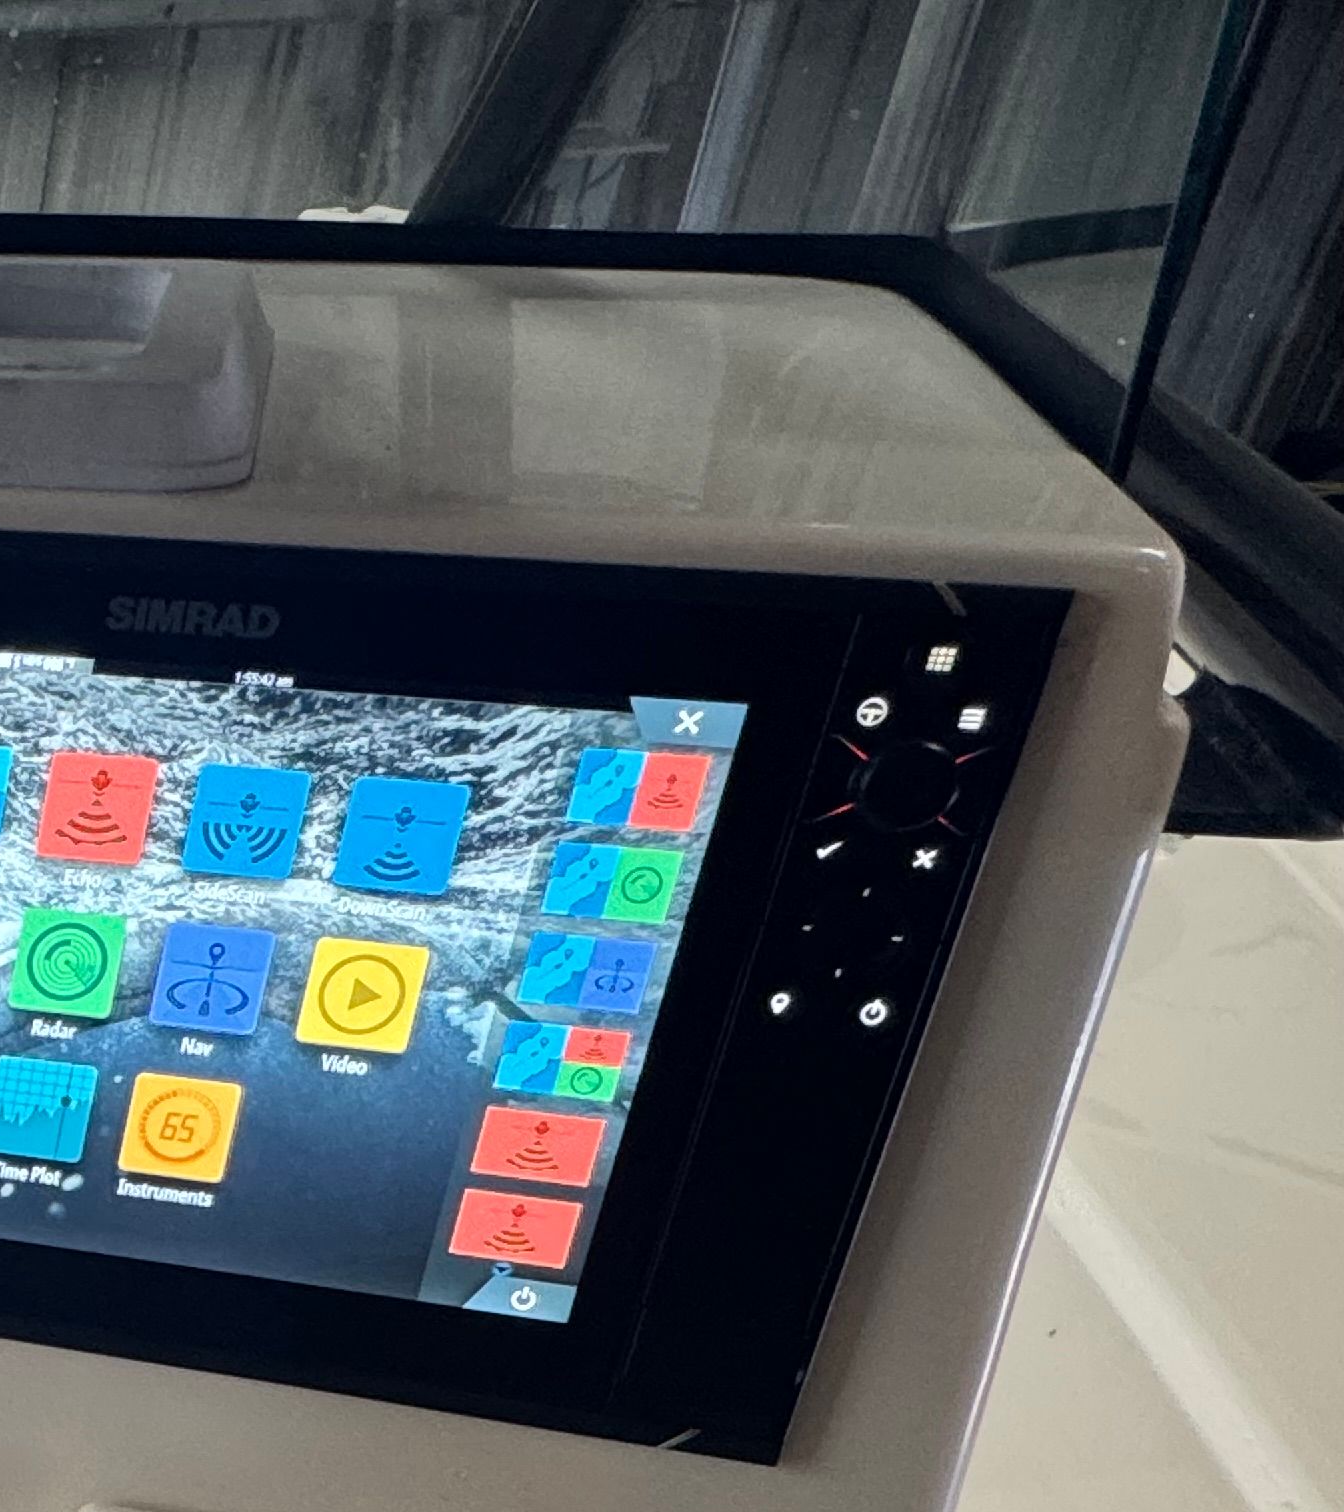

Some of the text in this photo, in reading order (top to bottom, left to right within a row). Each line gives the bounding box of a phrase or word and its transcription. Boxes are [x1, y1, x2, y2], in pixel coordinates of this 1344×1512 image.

[104, 596, 282, 639] SIMRAD
[64, 868, 103, 888] Echo
[194, 882, 267, 904] SideScan
[337, 898, 428, 922] DownScan
[30, 1018, 77, 1040] Radar
[180, 1037, 215, 1058] Nav
[320, 1054, 369, 1076] Video
[159, 1112, 199, 1144] 65
[30, 1166, 63, 1188] Plot
[116, 1178, 215, 1208] Instruments
